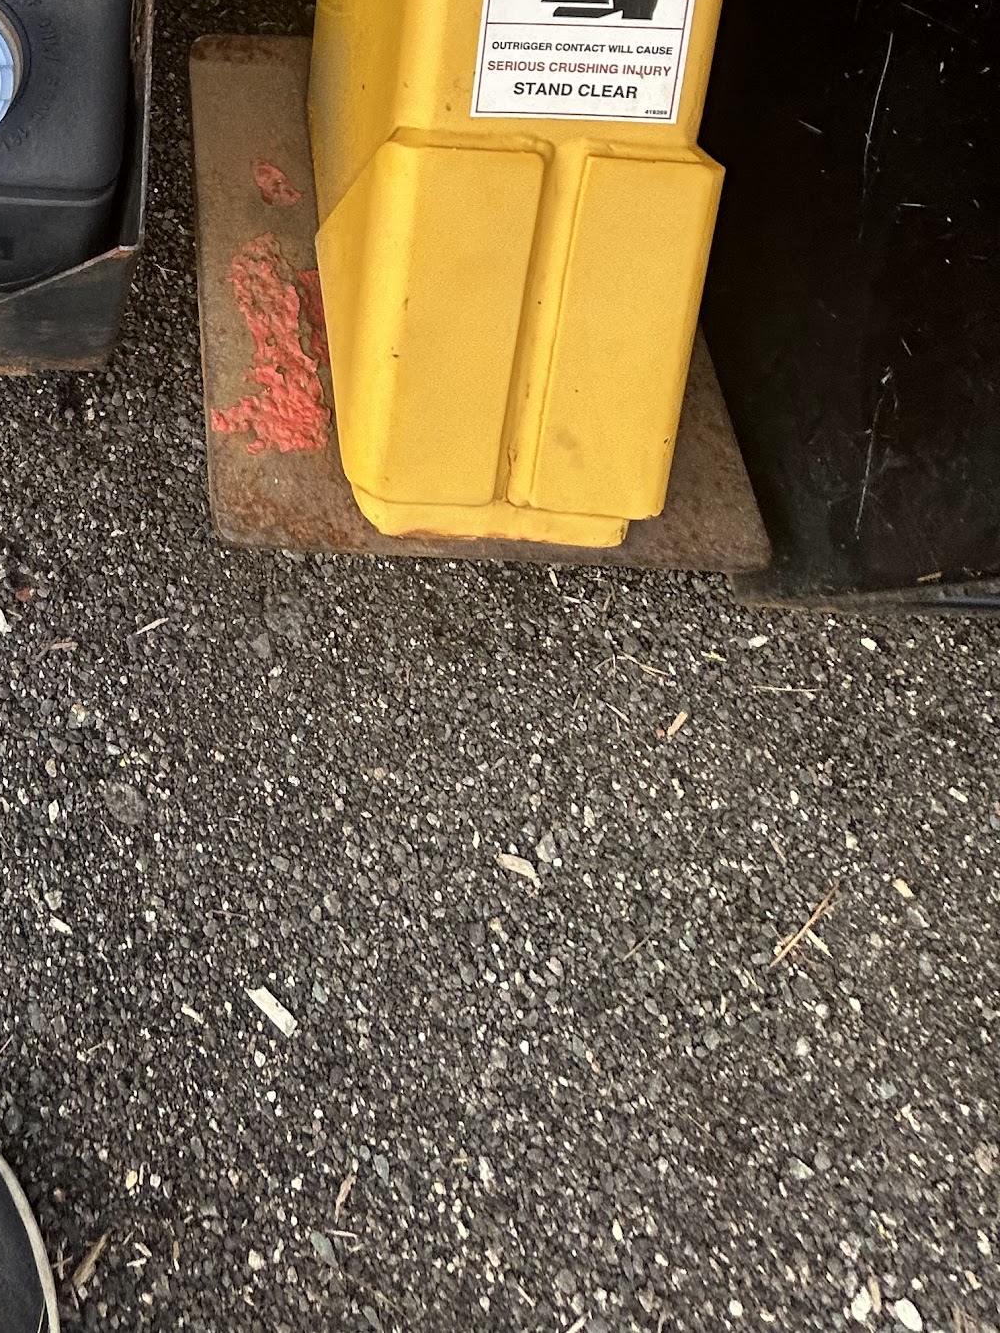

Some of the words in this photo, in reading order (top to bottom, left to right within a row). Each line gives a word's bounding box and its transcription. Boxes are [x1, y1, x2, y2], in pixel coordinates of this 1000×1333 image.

[491, 41, 553, 51] OUTRIGGER
[555, 42, 606, 54] CONTACT
[608, 44, 634, 55] WILL
[635, 45, 673, 56] CAUSE
[487, 60, 545, 72] SERIOUS
[548, 62, 619, 74] CRUSHING
[622, 64, 672, 77] INJURY
[513, 82, 573, 97] STAND
[578, 84, 638, 99] CLEAR
